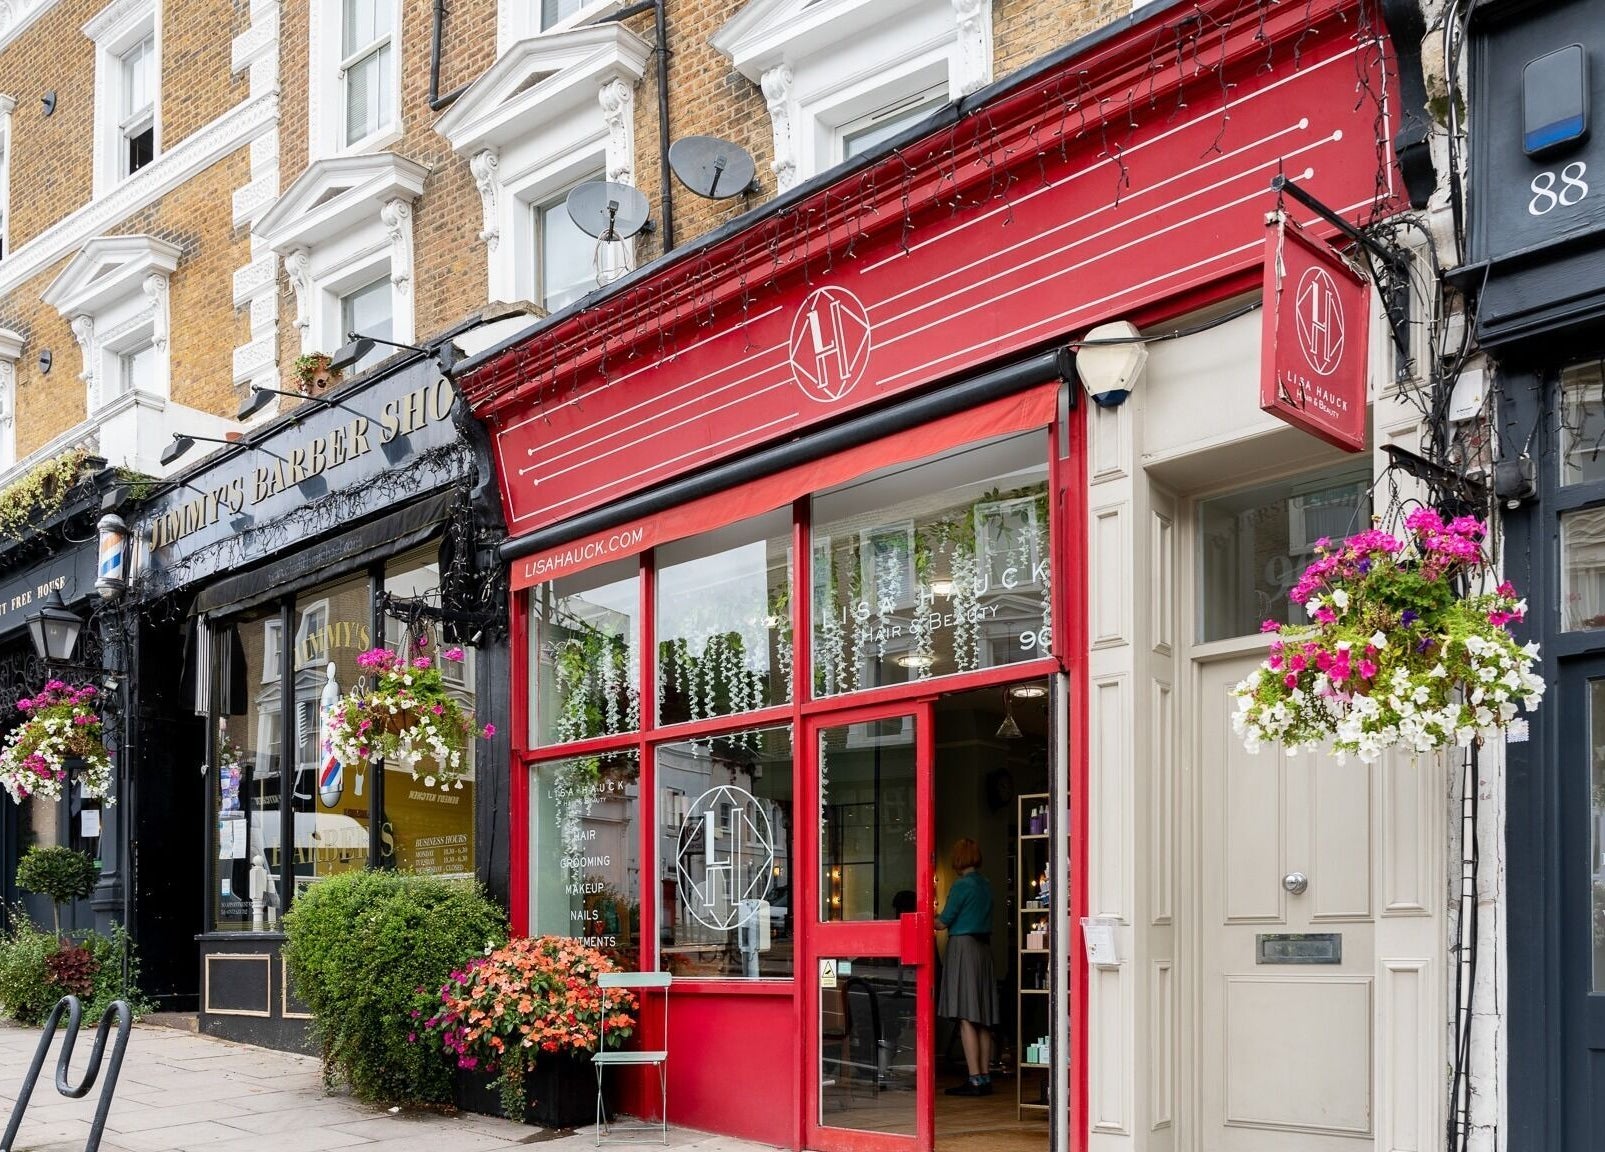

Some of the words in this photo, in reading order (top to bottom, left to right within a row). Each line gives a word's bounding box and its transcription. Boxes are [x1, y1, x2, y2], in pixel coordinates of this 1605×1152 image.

[1528, 161, 1589, 216] 88
[1287, 370, 1312, 391] LISA
[1316, 386, 1348, 411] HAUCK
[149, 475, 245, 553] JIMMY'S
[250, 416, 371, 506] BARBER
[525, 527, 643, 578] LISAHAUCK.COM
[11, 590, 32, 611] FREE
[37, 575, 66, 599] HOUSE
[823, 597, 895, 629] LISA
[920, 560, 1047, 606] HAUCK
[862, 625, 902, 643] HAIR
[929, 604, 998, 631] BEAUTY
[581, 780, 624, 795] HAUCK
[415, 836, 445, 848] BUSINESS
[445, 834, 468, 845] HOURS
[573, 830, 596, 841] HAIR
[560, 855, 610, 869] GROOMING
[565, 882, 604, 895] MAKEUP
[570, 909, 599, 921] NAILS
